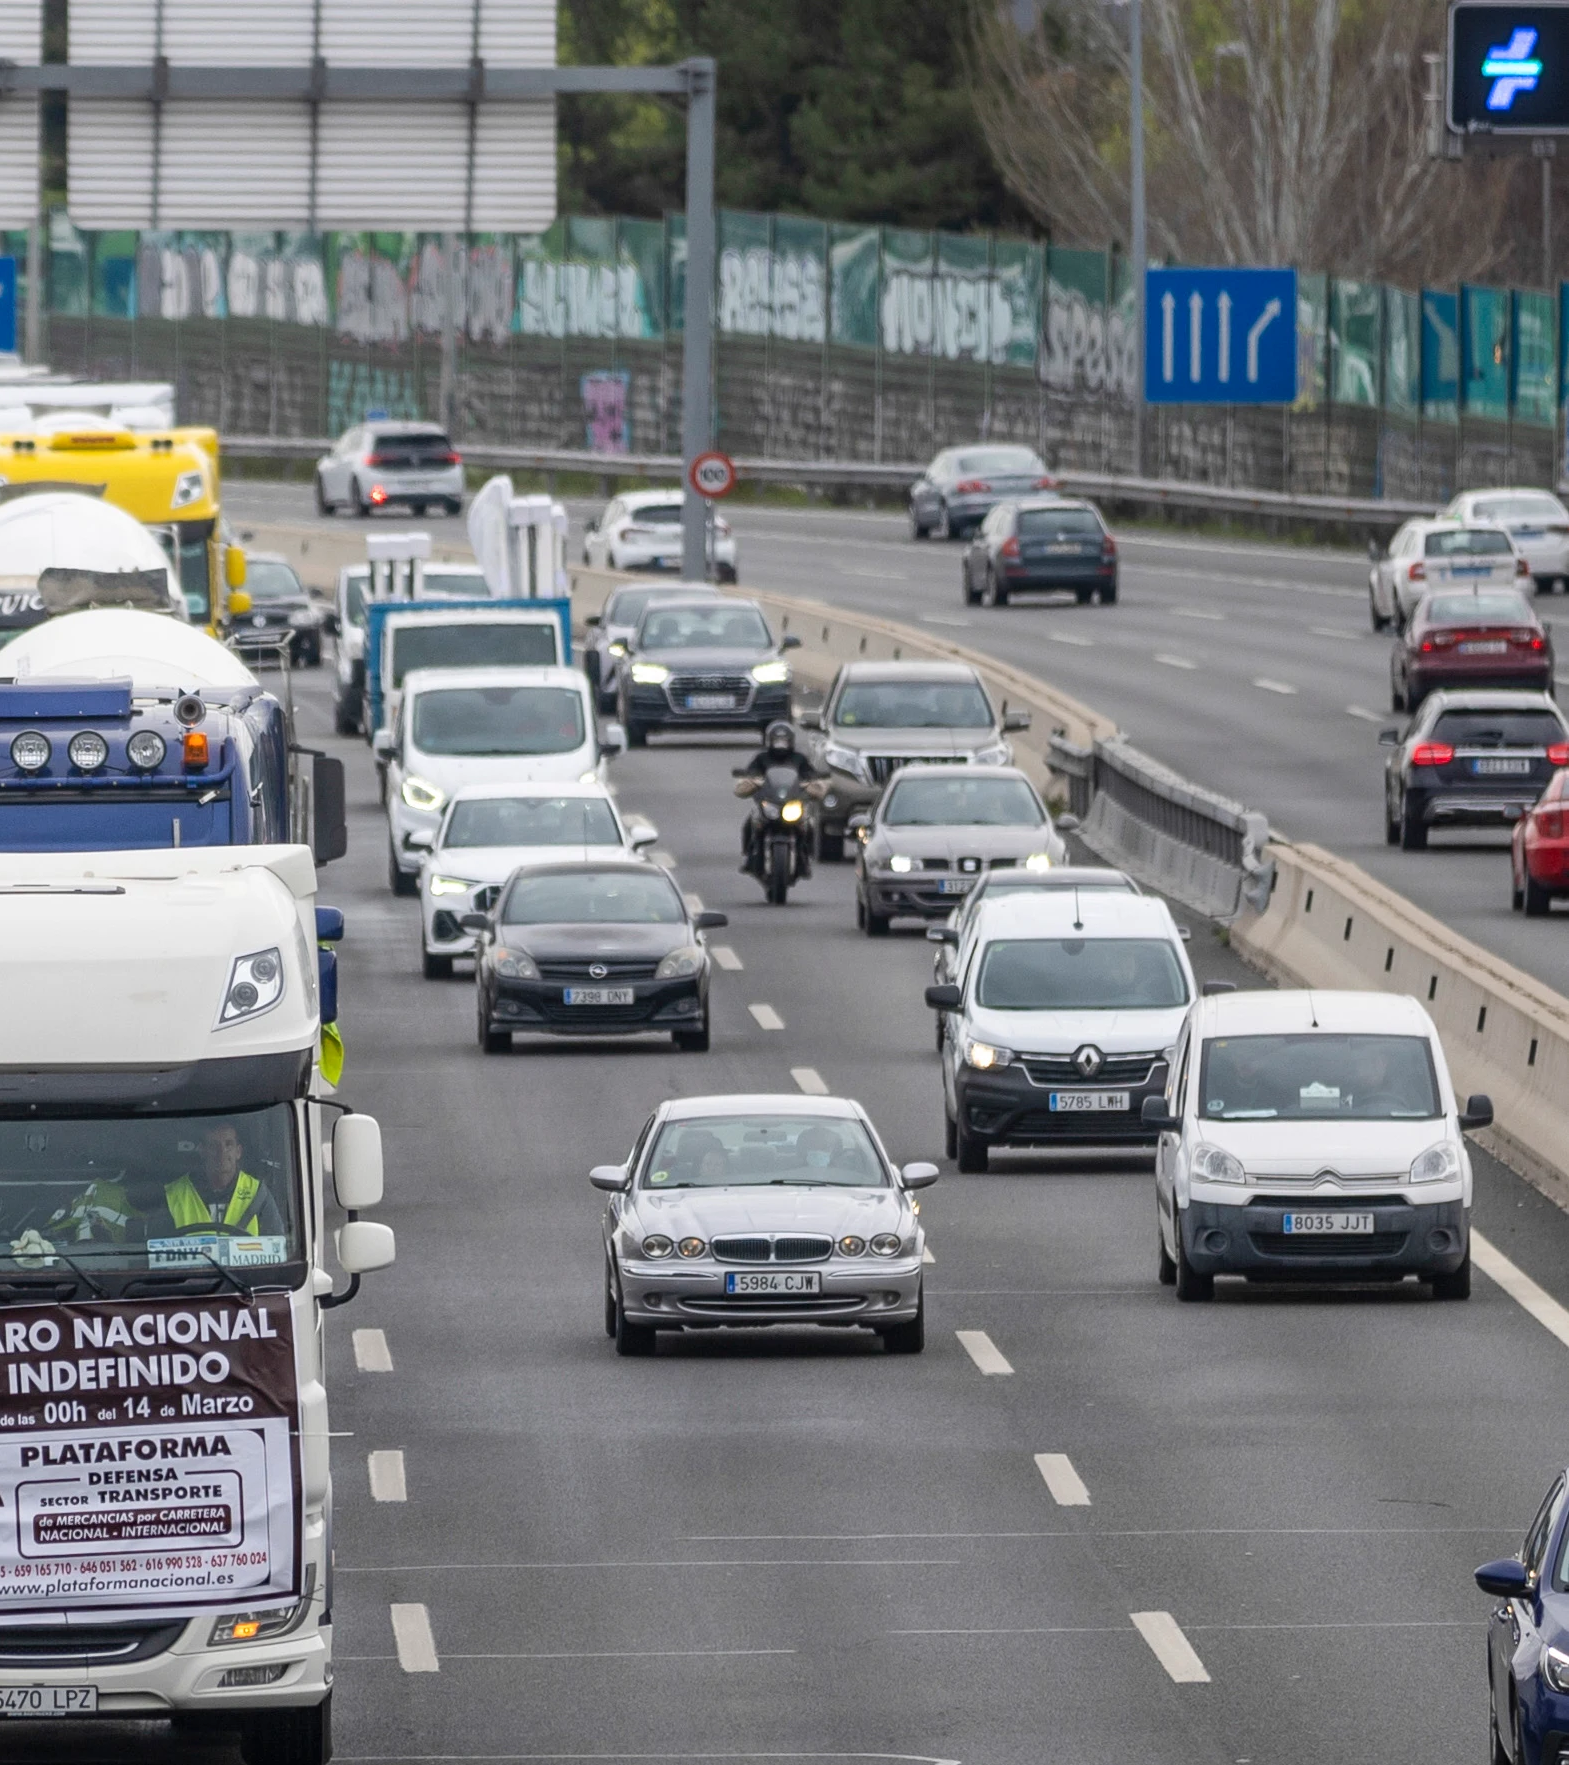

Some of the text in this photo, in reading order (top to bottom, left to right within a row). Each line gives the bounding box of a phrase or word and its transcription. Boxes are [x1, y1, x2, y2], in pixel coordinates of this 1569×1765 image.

[700, 468, 727, 483] 100
[1059, 1095, 1124, 1109] 5785 LWH
[1294, 1215, 1369, 1230] 8035 JJT
[155, 1247, 199, 1262] FDNY
[232, 1254, 281, 1266] MADRID
[740, 1275, 814, 1291] 5984 CJW
[73, 1307, 277, 1350] NACIONAL
[8, 1351, 231, 1395] INDEFINIDO
[17, 1413, 36, 1426] las
[44, 1400, 87, 1424] 00h
[97, 1408, 116, 1421] del
[123, 1396, 151, 1419] 14
[160, 1404, 175, 1417] de
[182, 1393, 254, 1416] Marzo
[20, 1435, 232, 1468] PLATAFORMA
[88, 1467, 179, 1486] DEFENSA
[39, 1484, 223, 1508] SECTOR TRANSPORTE
[39, 1507, 226, 1527] de MERCANCIAS por CARRETERA
[39, 1526, 110, 1542] NACIONAL
[121, 1522, 227, 1538] INTERNACIONAL
[14, 1564, 32, 1577] 659
[35, 1563, 51, 1576] 165
[54, 1562, 71, 1575] 710
[80, 1561, 97, 1574] 646
[99, 1560, 116, 1573] 051
[120, 1559, 137, 1571] 562
[145, 1558, 163, 1570] 616
[165, 1557, 183, 1569] 990
[185, 1556, 202, 1568] 528
[211, 1554, 228, 1567] 637
[230, 1553, 247, 1566] 760
[250, 1551, 267, 1564] 024
[53, 1689, 91, 1709] LPZ
